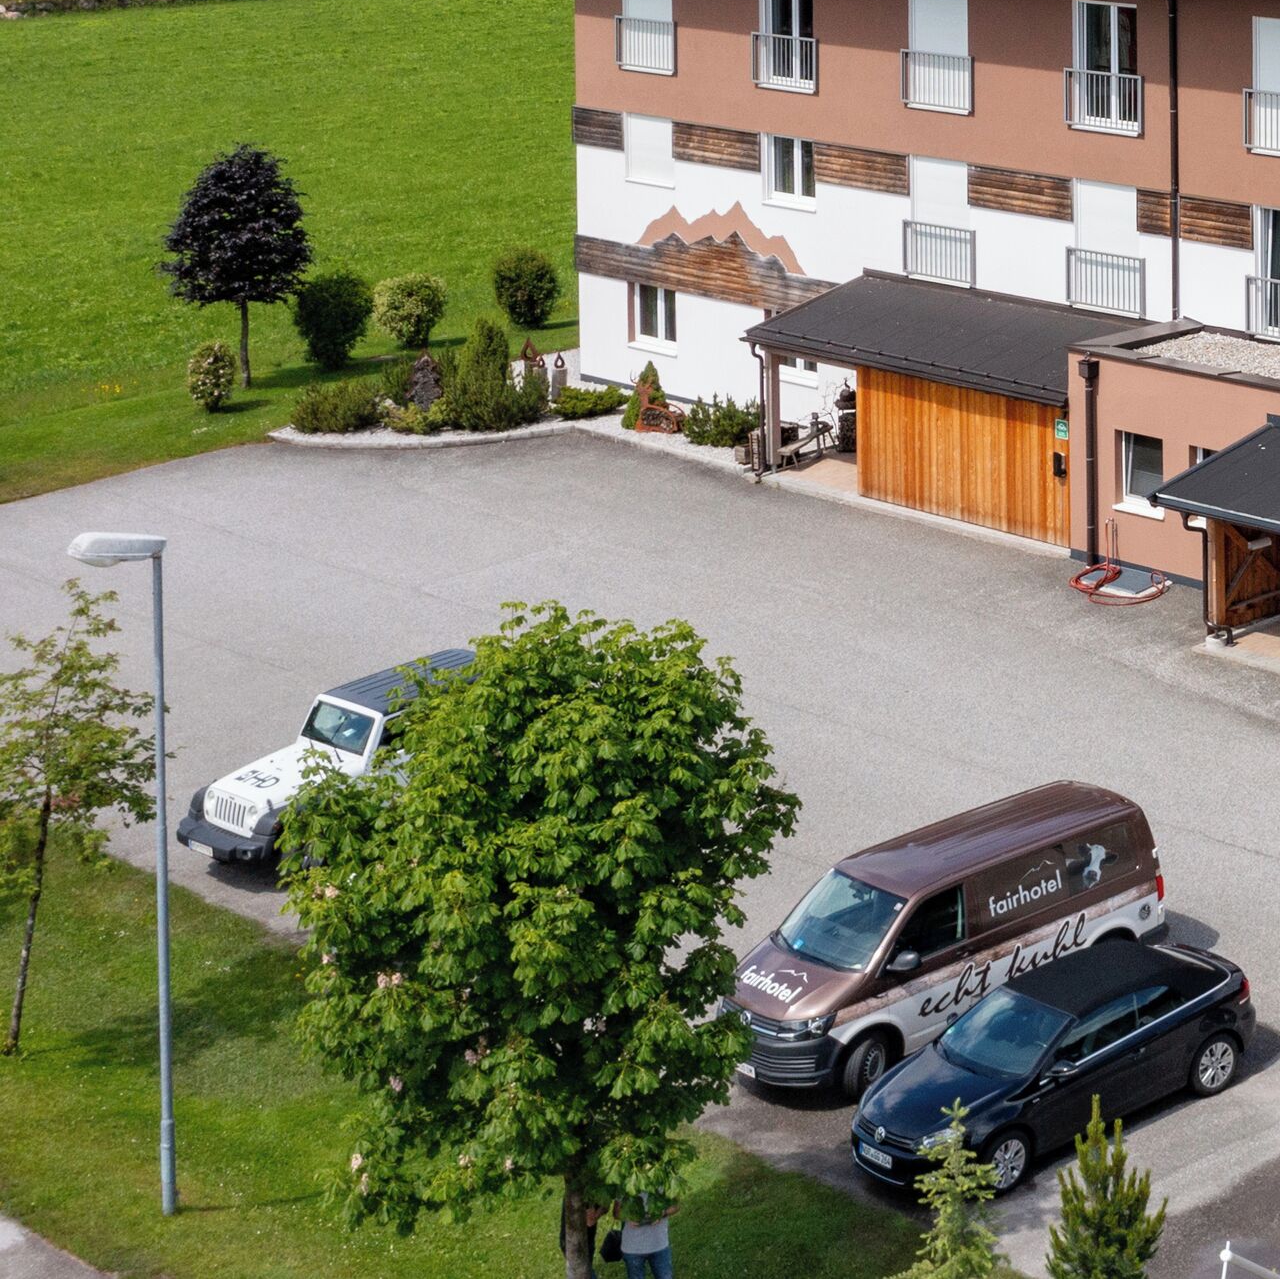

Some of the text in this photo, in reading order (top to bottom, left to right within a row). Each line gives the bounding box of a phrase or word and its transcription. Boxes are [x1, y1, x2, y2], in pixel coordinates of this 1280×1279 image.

[988, 869, 1063, 918] fairhotel
[741, 965, 803, 1003] fairhotel
[918, 963, 992, 1017] echt
